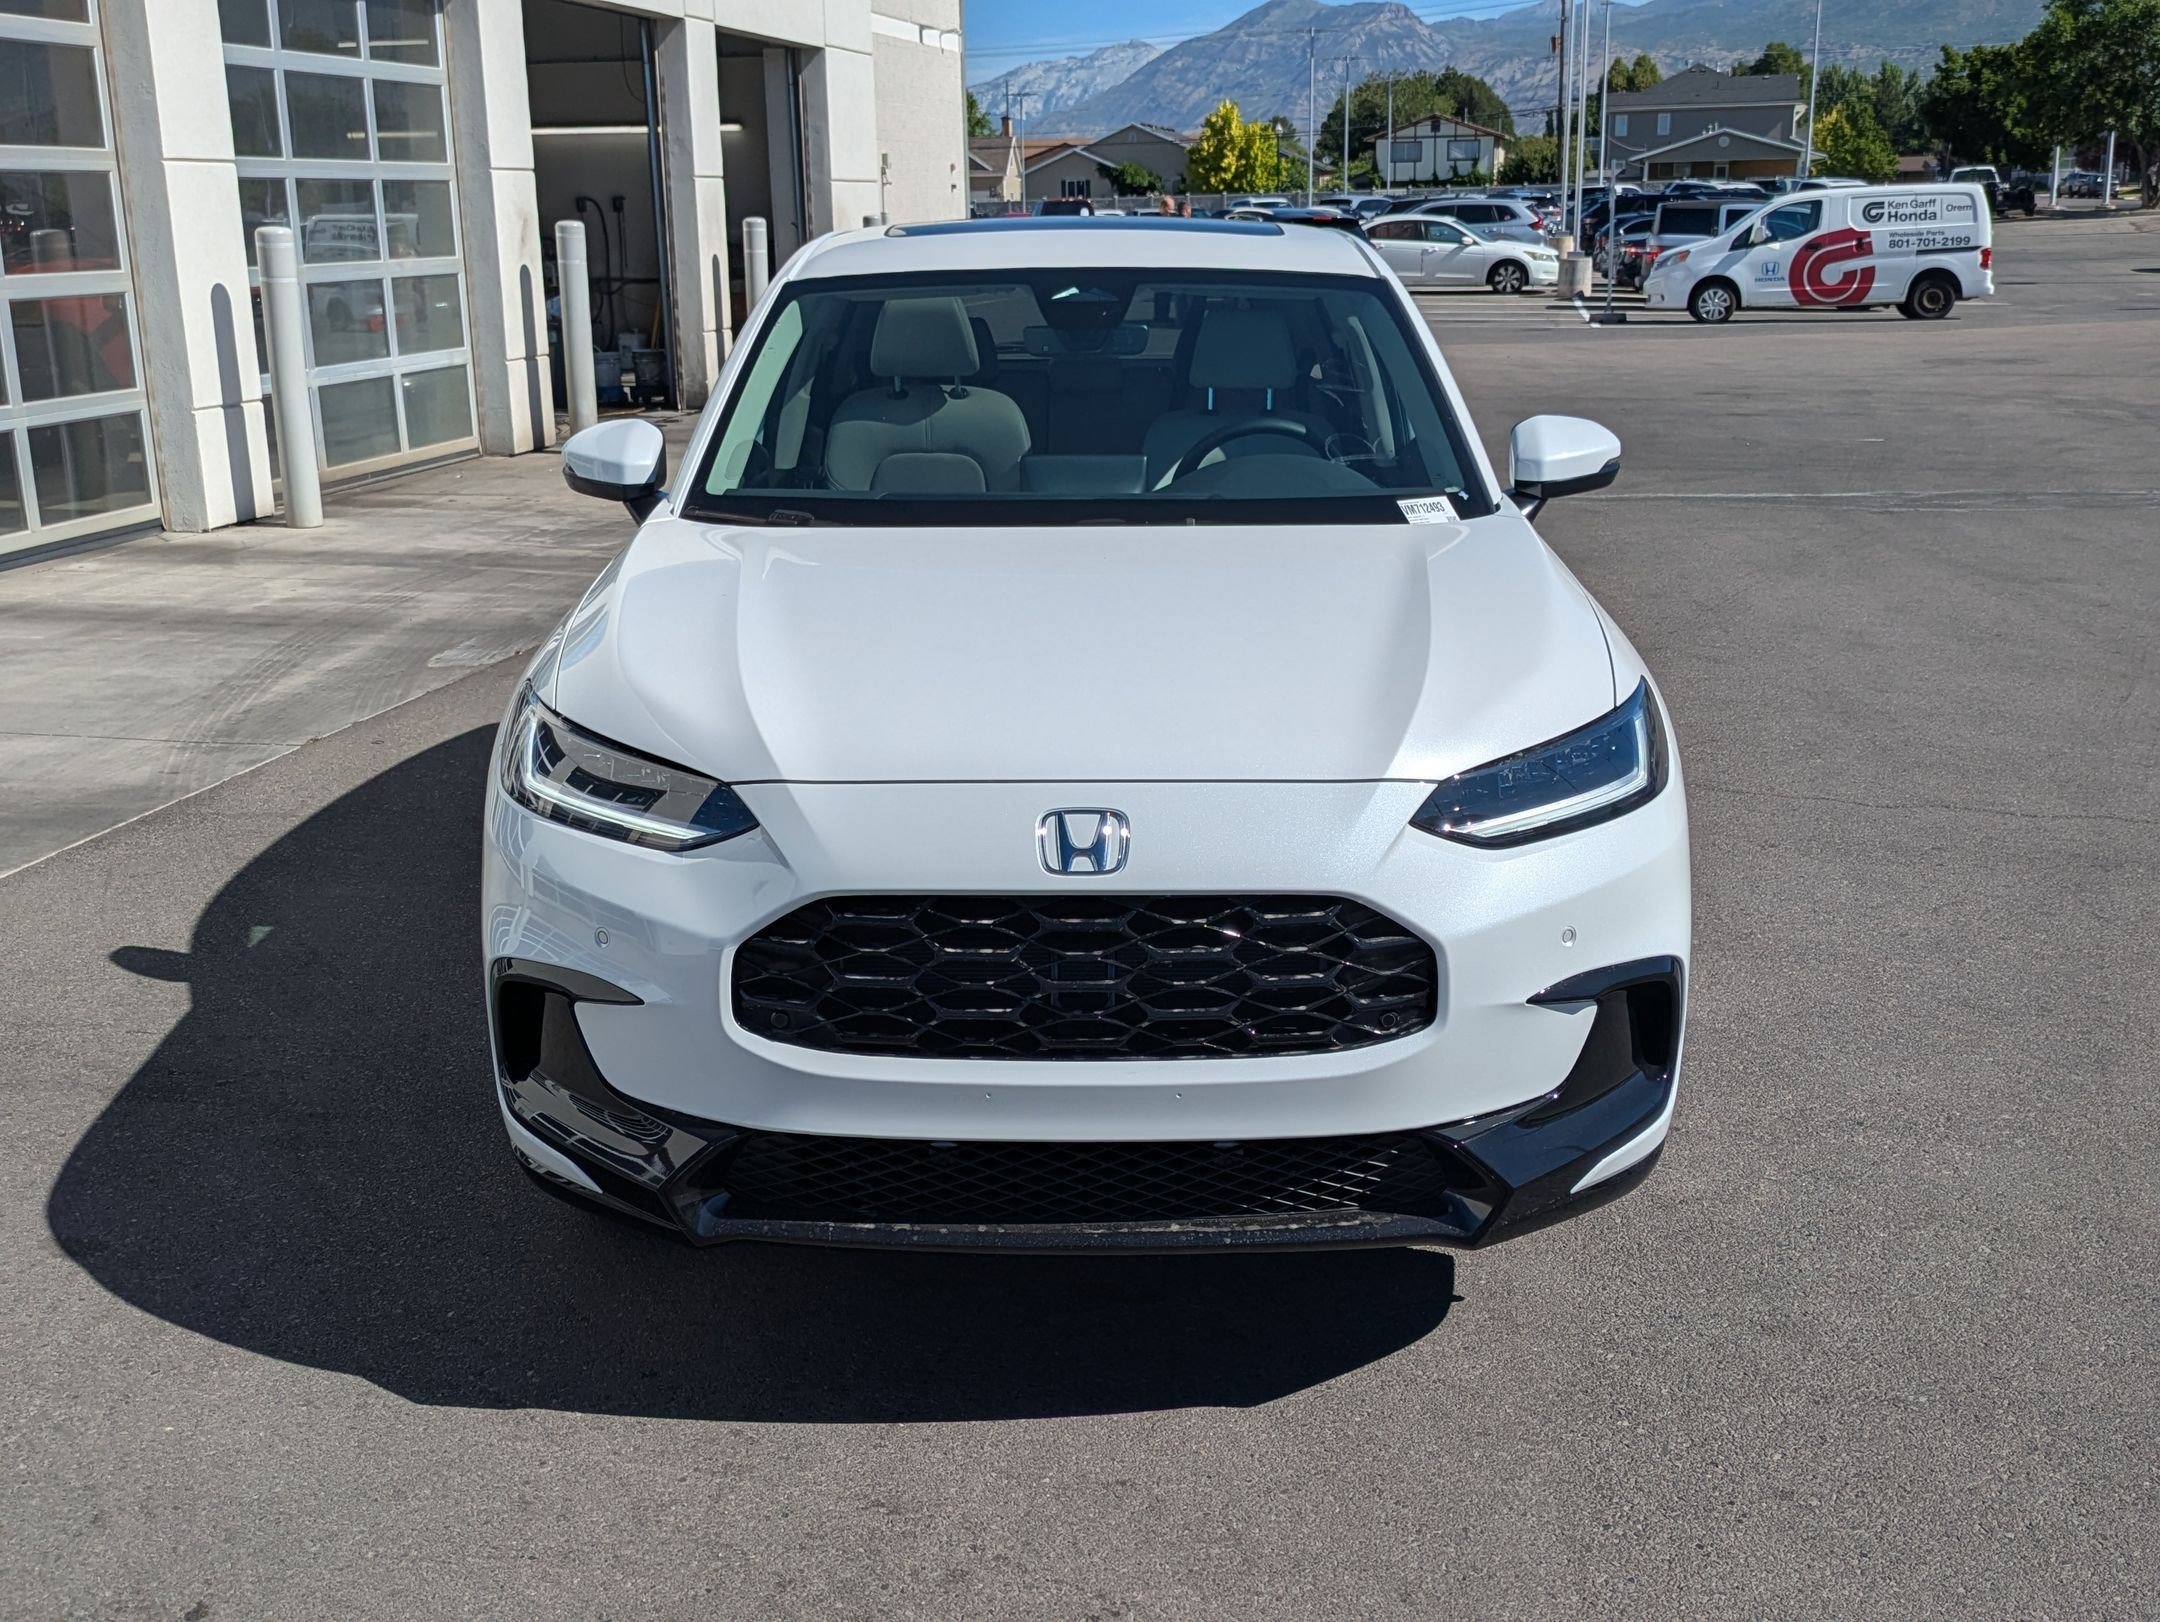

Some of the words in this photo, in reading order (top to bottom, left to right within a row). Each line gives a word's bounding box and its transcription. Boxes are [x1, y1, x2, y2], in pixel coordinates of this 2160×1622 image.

[1887, 200, 1909, 210] Ken
[1909, 198, 1936, 209] Garff
[1945, 203, 1973, 212] Orem
[1887, 209, 1937, 222] Honda
[1888, 236, 1971, 249] 801-701-2199
[1400, 501, 1445, 515] VM712493
